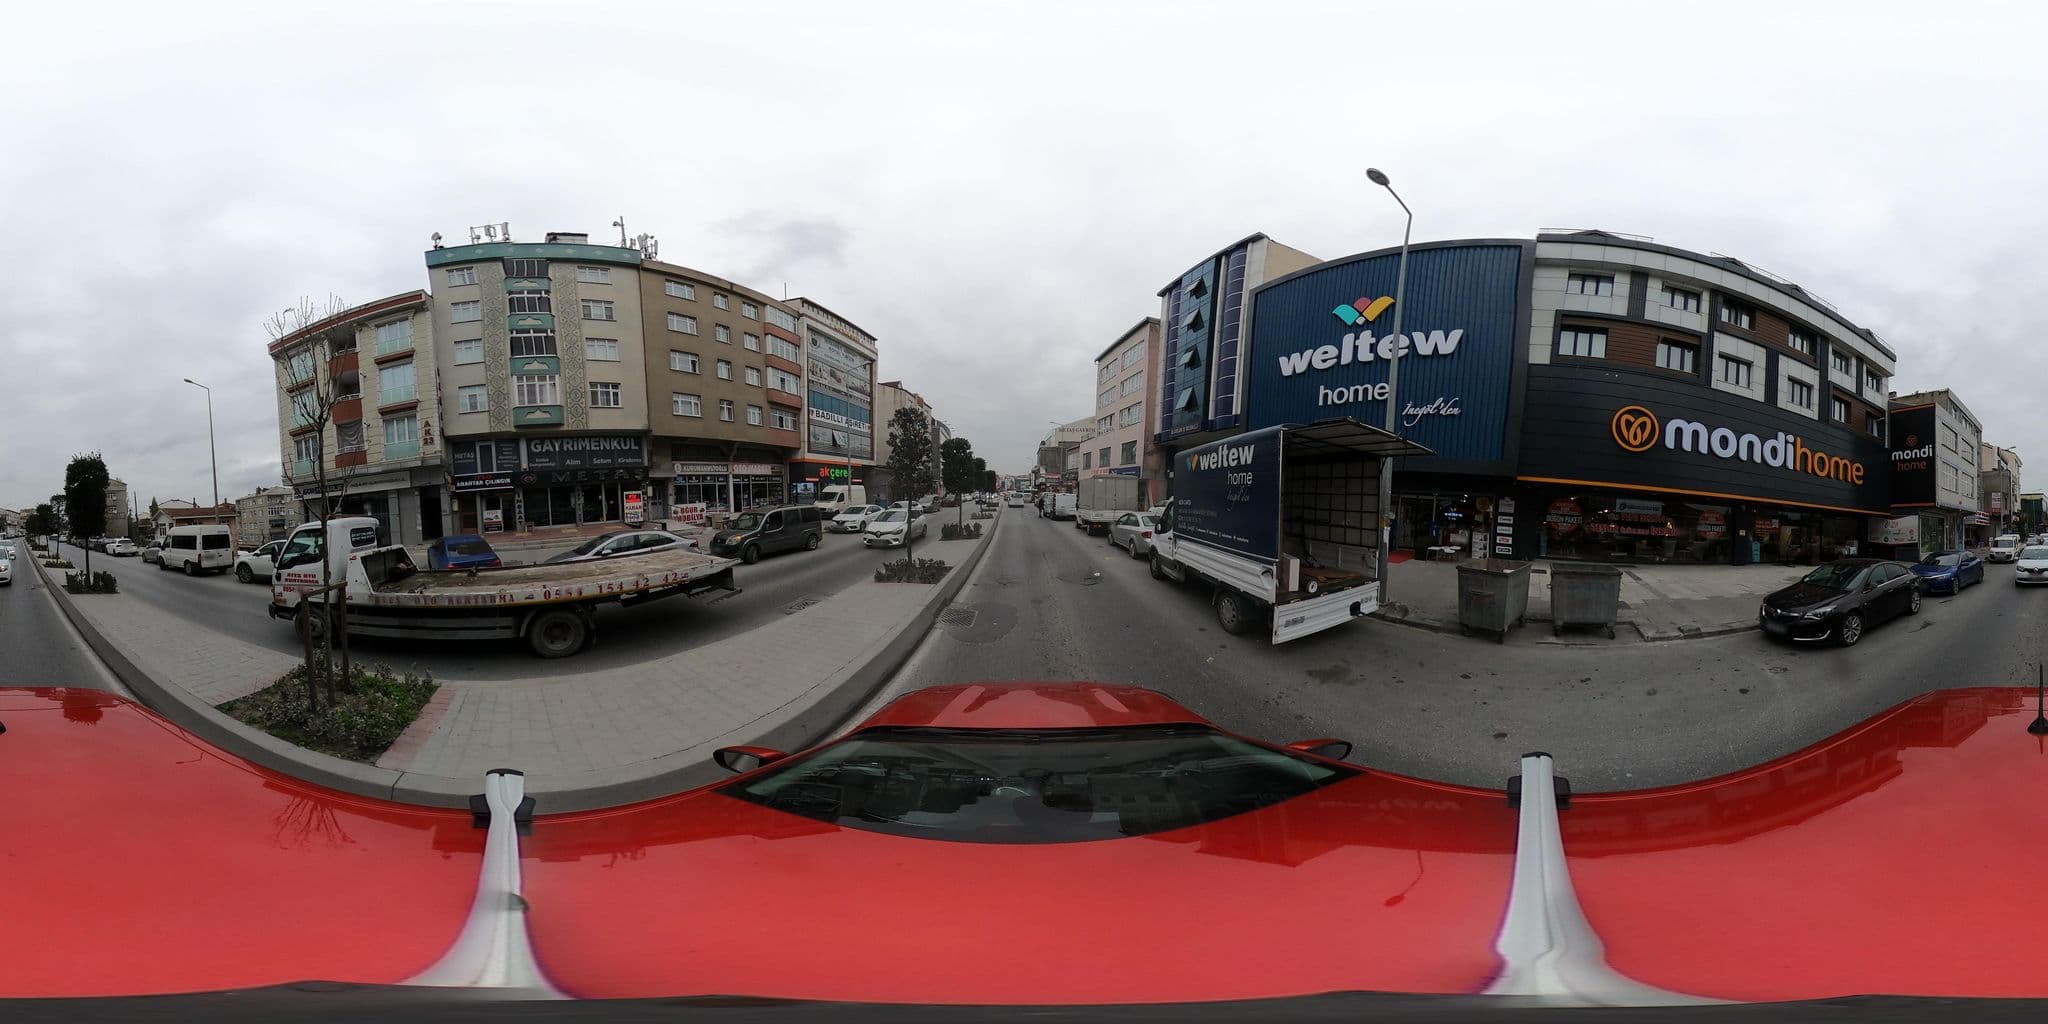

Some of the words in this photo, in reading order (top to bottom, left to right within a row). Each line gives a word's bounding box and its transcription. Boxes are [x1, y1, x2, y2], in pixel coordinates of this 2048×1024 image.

[1278, 328, 1464, 377] weltew
[1318, 382, 1389, 407] home
[1199, 444, 1255, 471] weltew
[1664, 418, 1865, 486] mondihome
[1891, 444, 1933, 461] mondi
[1897, 461, 1927, 472] home
[1227, 470, 1252, 485] home
[632, 577, 650, 588] 42
